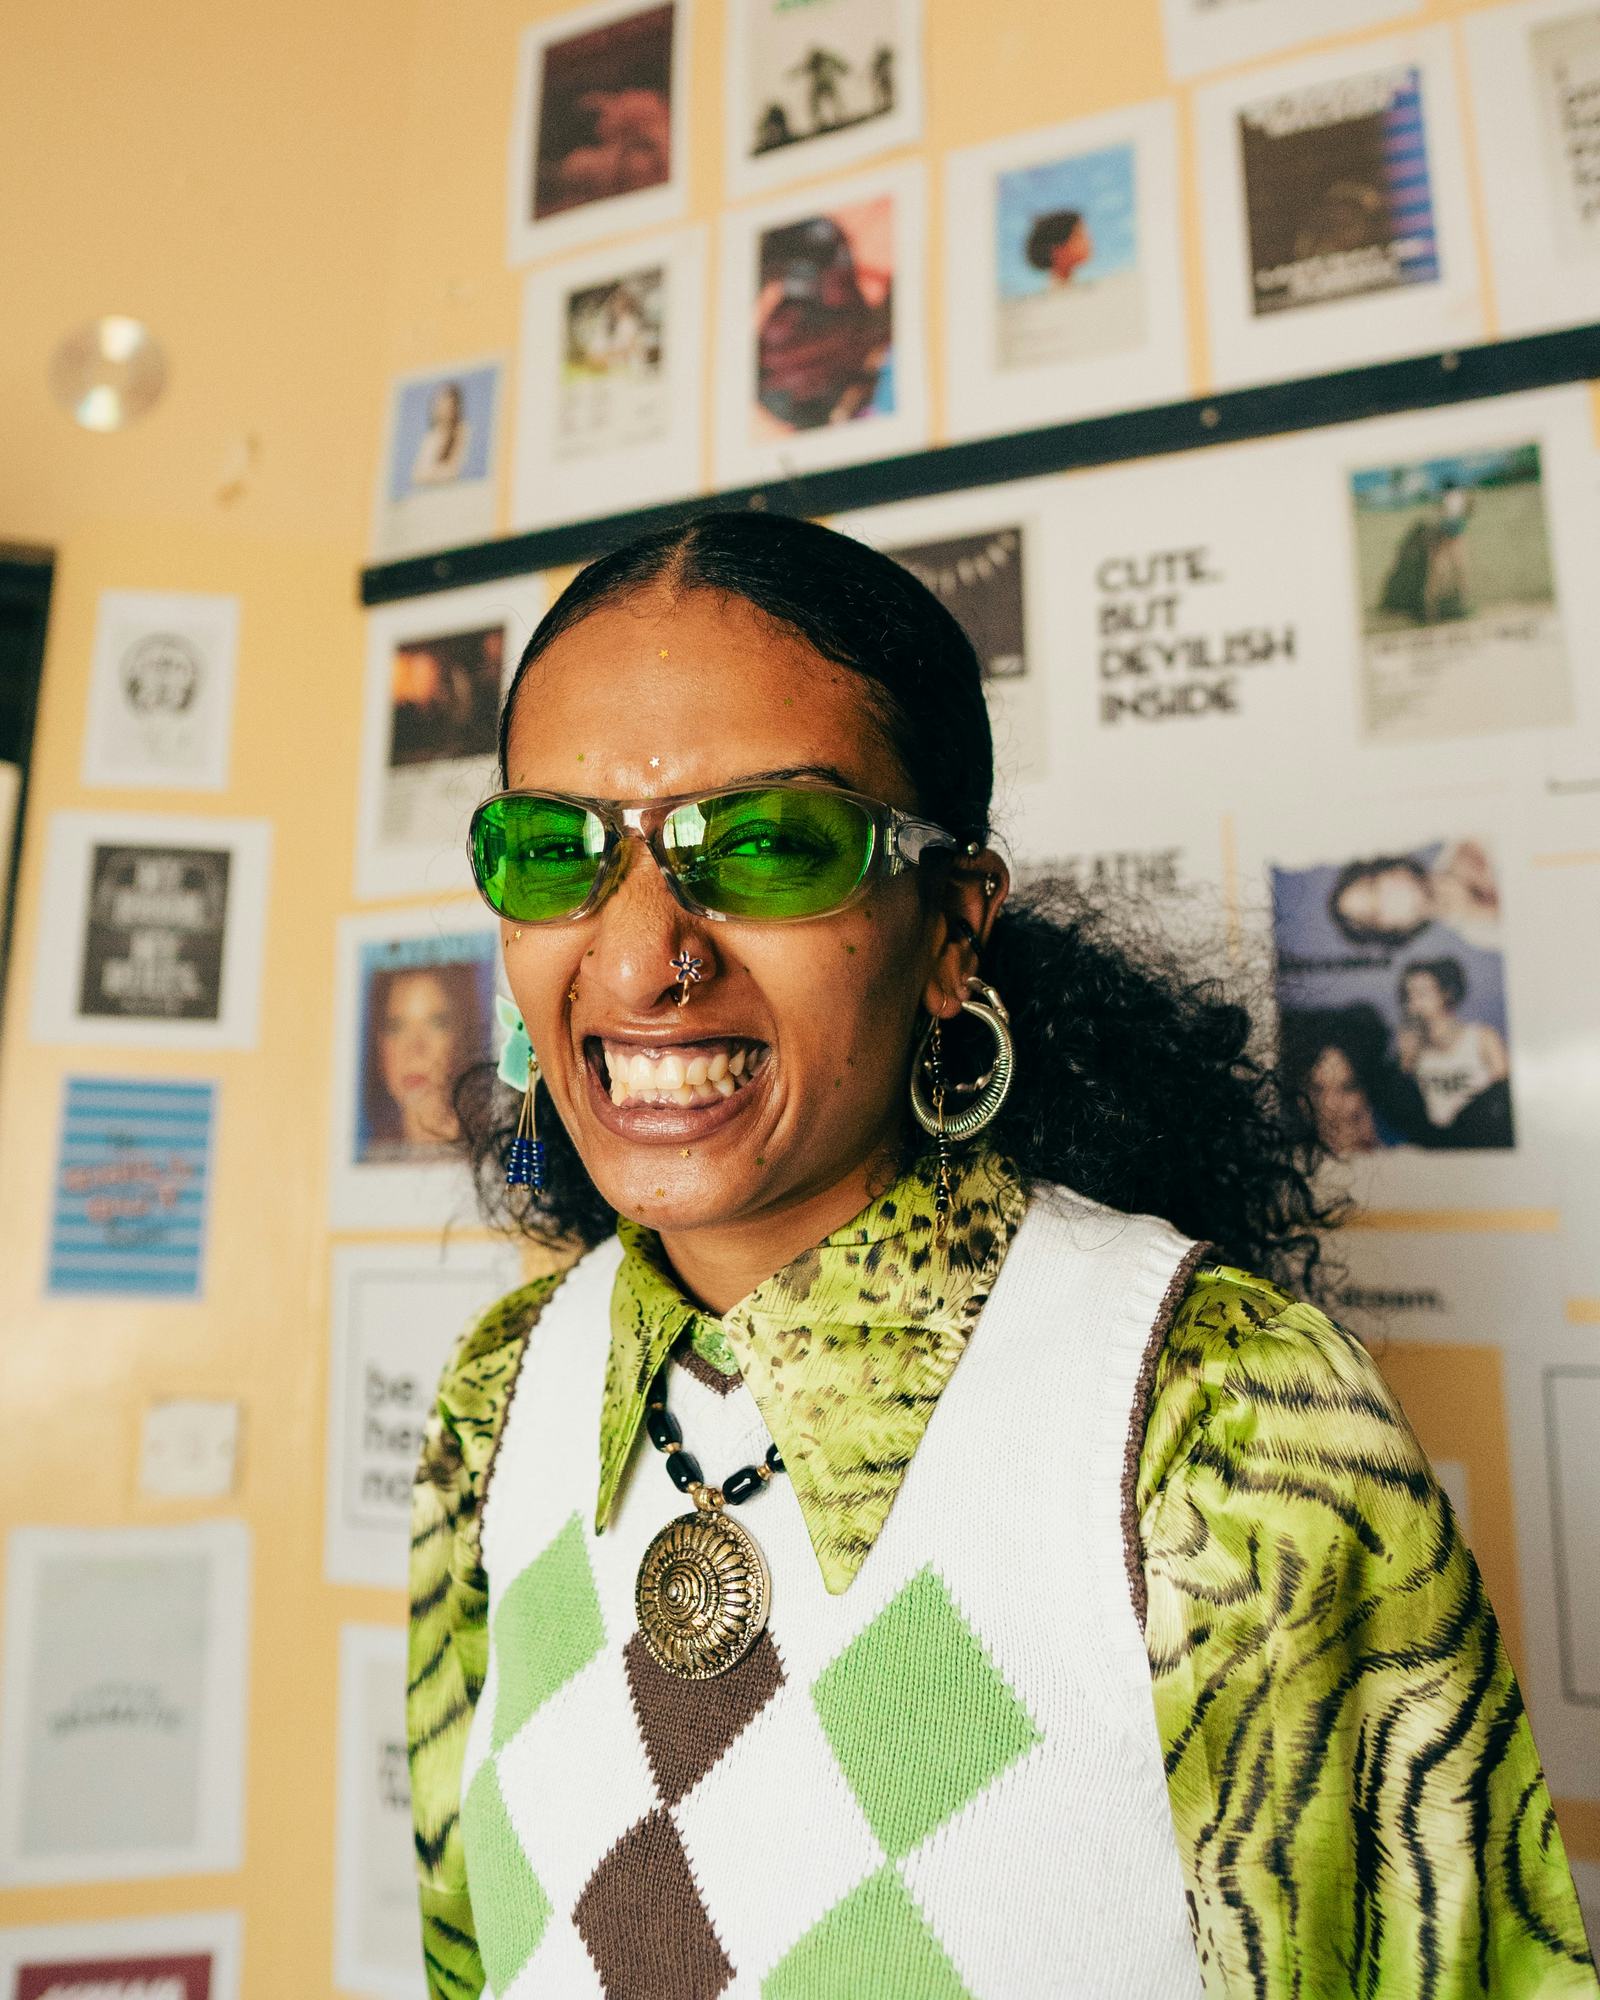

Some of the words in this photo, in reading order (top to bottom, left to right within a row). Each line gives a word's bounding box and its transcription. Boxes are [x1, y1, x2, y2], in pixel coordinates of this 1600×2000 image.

[1099, 595, 1179, 635] BUT
[1100, 624, 1297, 679] DEVILISH
[1101, 680, 1239, 724] INSIDE
